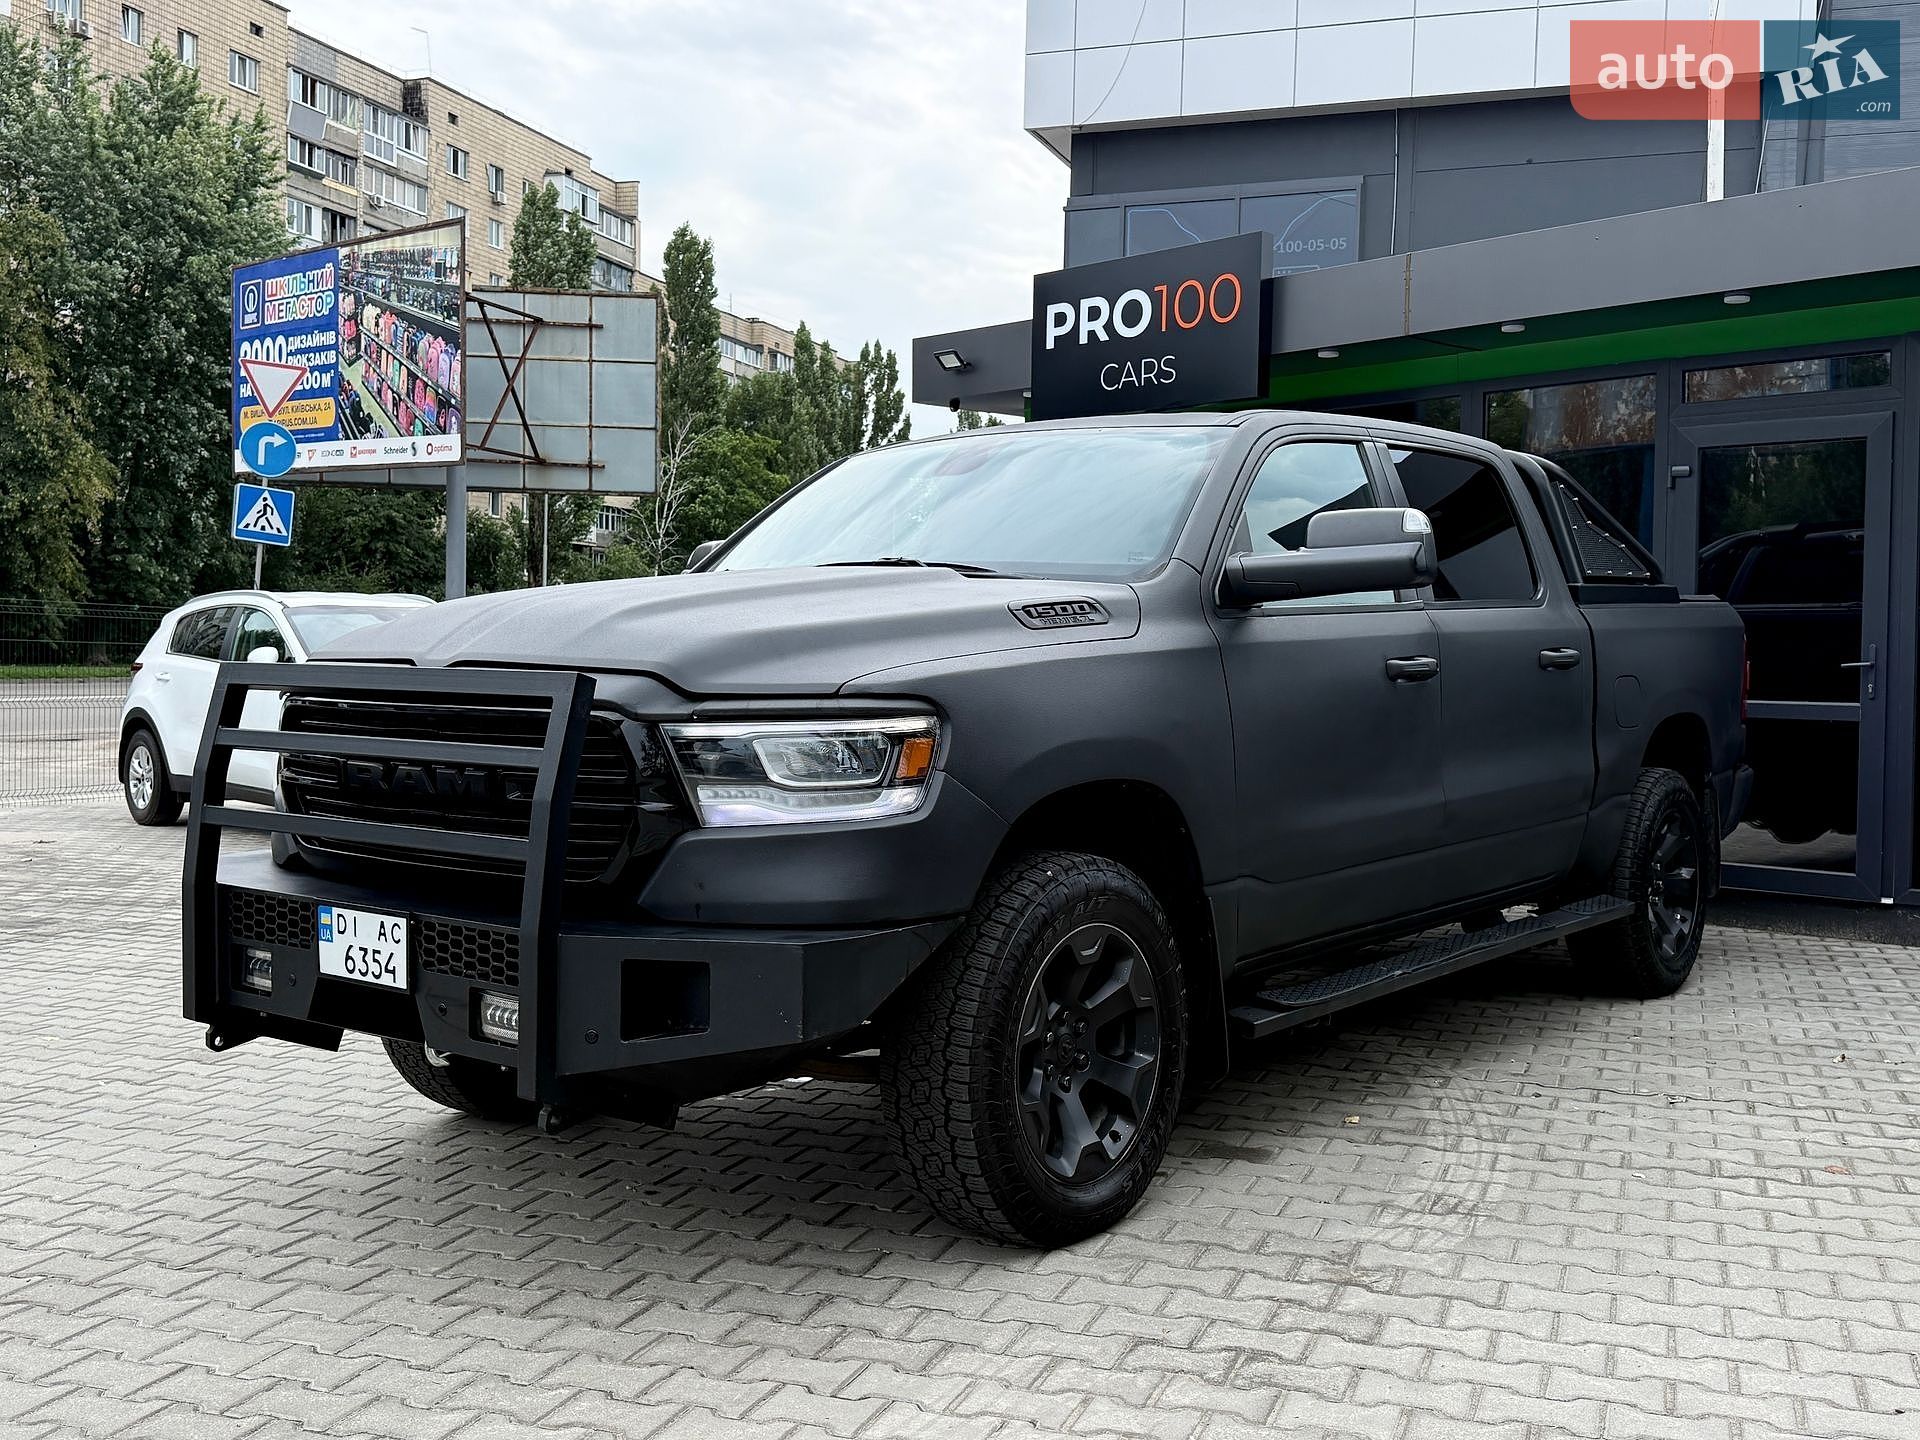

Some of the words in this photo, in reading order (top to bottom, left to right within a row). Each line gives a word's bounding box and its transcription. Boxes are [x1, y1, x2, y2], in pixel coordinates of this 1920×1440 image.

[264, 262, 334, 301] ШКІЛЬНИЙ
[264, 291, 335, 325] МЕГАСТОР
[1045, 272, 1242, 350] PRO100
[287, 330, 337, 353] ДИЗАЙНІВ
[1100, 355, 1177, 391] CARS
[383, 446, 409, 454] Schneider
[433, 444, 453, 454] optima
[1024, 603, 1091, 617] 1500
[347, 758, 489, 801] RAM
[320, 928, 332, 941] UA
[336, 912, 358, 938] DI
[377, 919, 402, 945] AC
[344, 943, 398, 984] 6354
